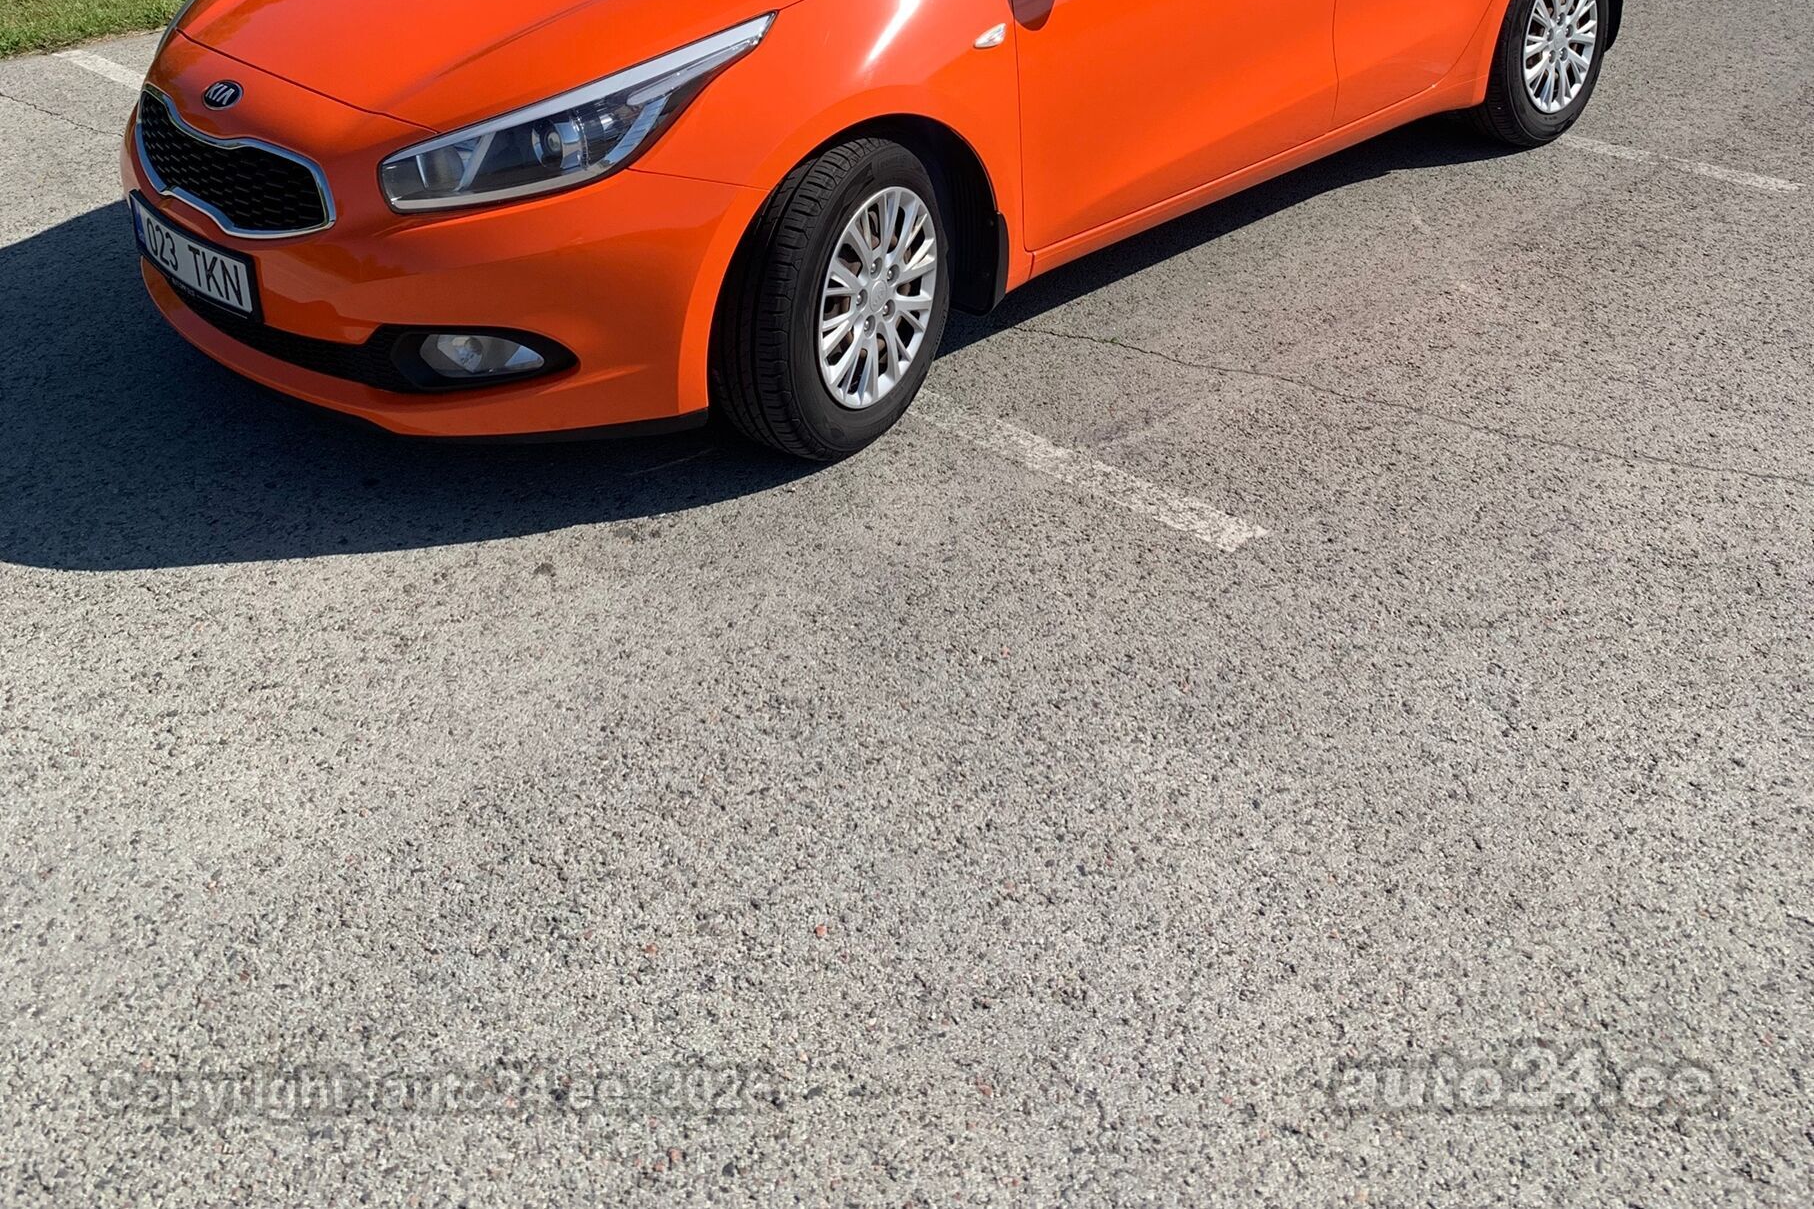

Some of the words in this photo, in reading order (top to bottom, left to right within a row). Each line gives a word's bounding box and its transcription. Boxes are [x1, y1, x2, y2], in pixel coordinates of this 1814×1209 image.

[205, 82, 235, 106] KIA
[146, 217, 179, 272] 023
[187, 244, 244, 307] TKN
